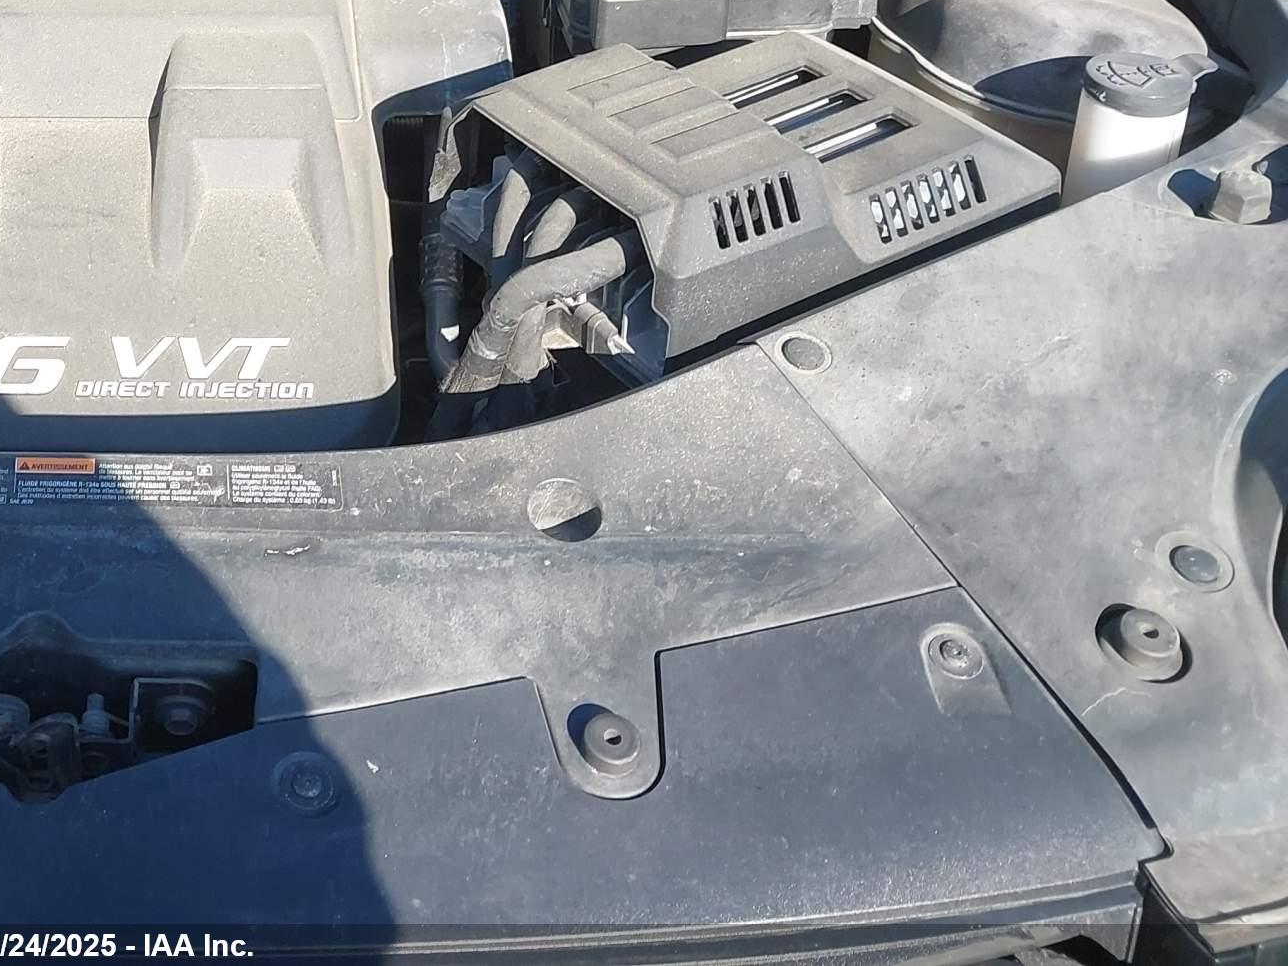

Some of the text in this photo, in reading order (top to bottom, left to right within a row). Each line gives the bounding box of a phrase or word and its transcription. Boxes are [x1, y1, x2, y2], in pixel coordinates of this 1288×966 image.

[111, 336, 290, 379] VVT
[75, 382, 313, 400] DIRECT INJECTION
